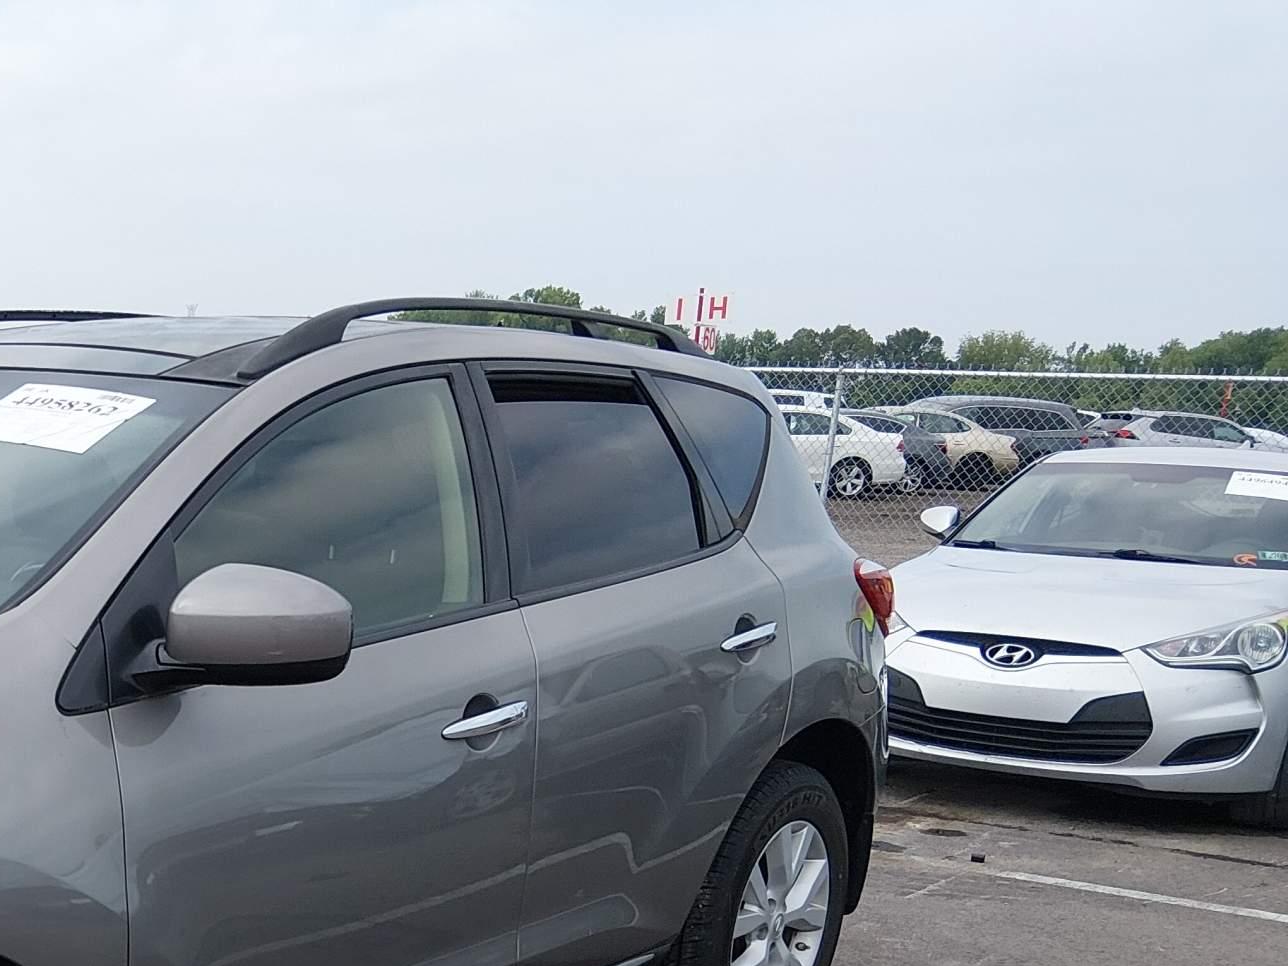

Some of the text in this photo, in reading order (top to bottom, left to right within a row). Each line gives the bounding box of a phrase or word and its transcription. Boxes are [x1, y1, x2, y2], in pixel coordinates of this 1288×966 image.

[708, 296, 728, 319] H
[703, 327, 716, 351] 60
[11, 395, 119, 416] 44958262
